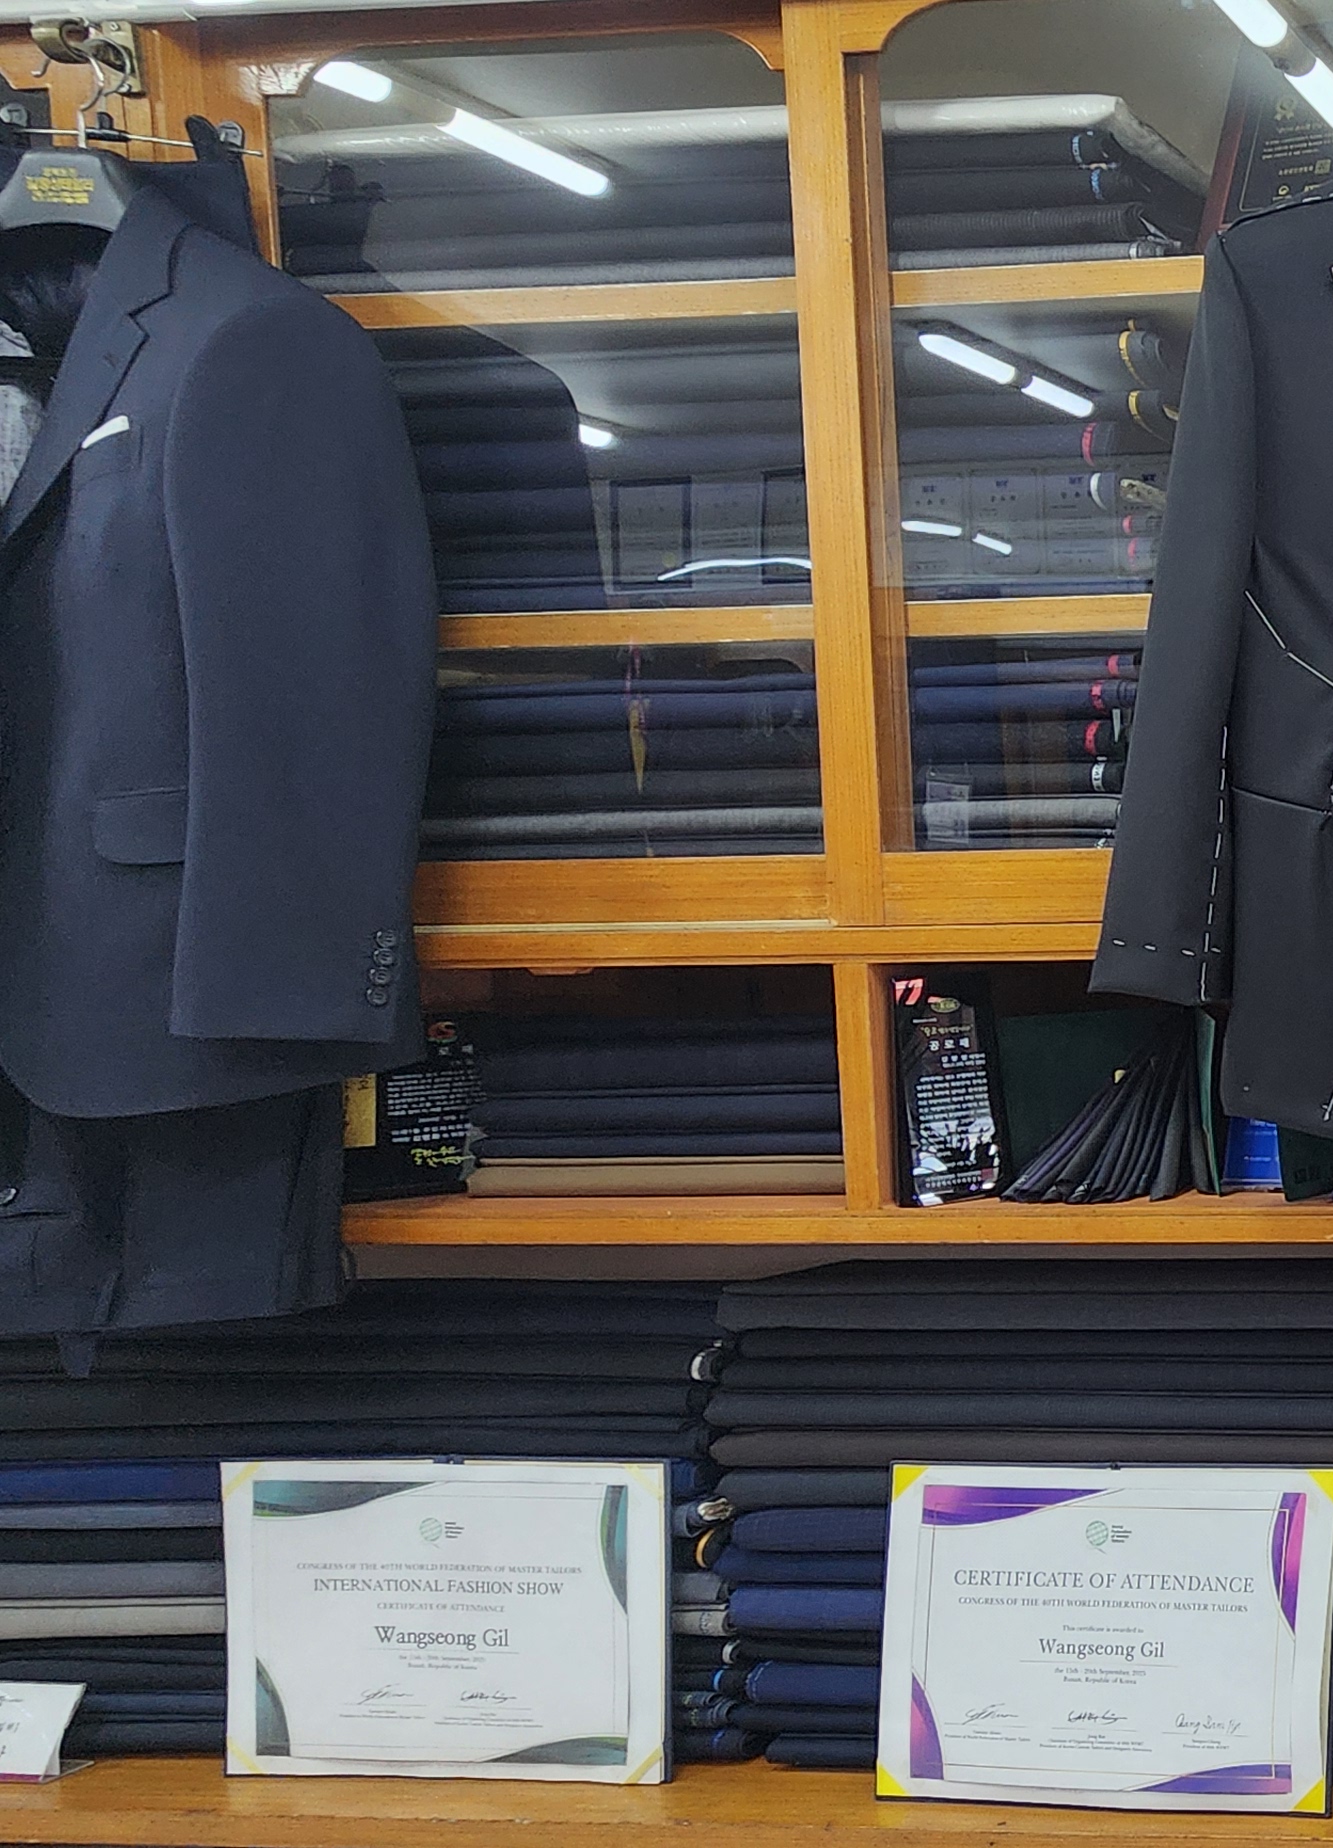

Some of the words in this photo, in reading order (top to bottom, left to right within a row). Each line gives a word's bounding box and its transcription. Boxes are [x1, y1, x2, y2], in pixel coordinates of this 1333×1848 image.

[508, 1566, 543, 1574] MASTER
[545, 1566, 582, 1575] TAILORS
[313, 1578, 444, 1593] INTERNATIONAL
[448, 1579, 513, 1594] FASHION
[517, 1581, 564, 1596] SHOW
[954, 1568, 1083, 1589] CERTIFICATE
[1089, 1572, 1117, 1590] OF
[1120, 1573, 1254, 1594] ATTENDANCE
[377, 1602, 434, 1611] CERTIFICATE
[436, 1602, 449, 1611] OF
[450, 1603, 505, 1613] ATTENDANCE
[958, 1596, 1005, 1607] CONGRESS
[1006, 1597, 1018, 1607] OF
[1021, 1597, 1040, 1607] THE
[1066, 1598, 1100, 1609] WORLD
[1101, 1599, 1157, 1610] FEDERATION
[1159, 1601, 1171, 1611] OF
[1173, 1602, 1209, 1612] MASTER
[1211, 1603, 1248, 1613] TAILORS
[374, 1625, 476, 1650] Wangseong
[483, 1628, 509, 1647] Gil
[1038, 1638, 1136, 1661] Wangseong
[1140, 1641, 1165, 1658] Gil
